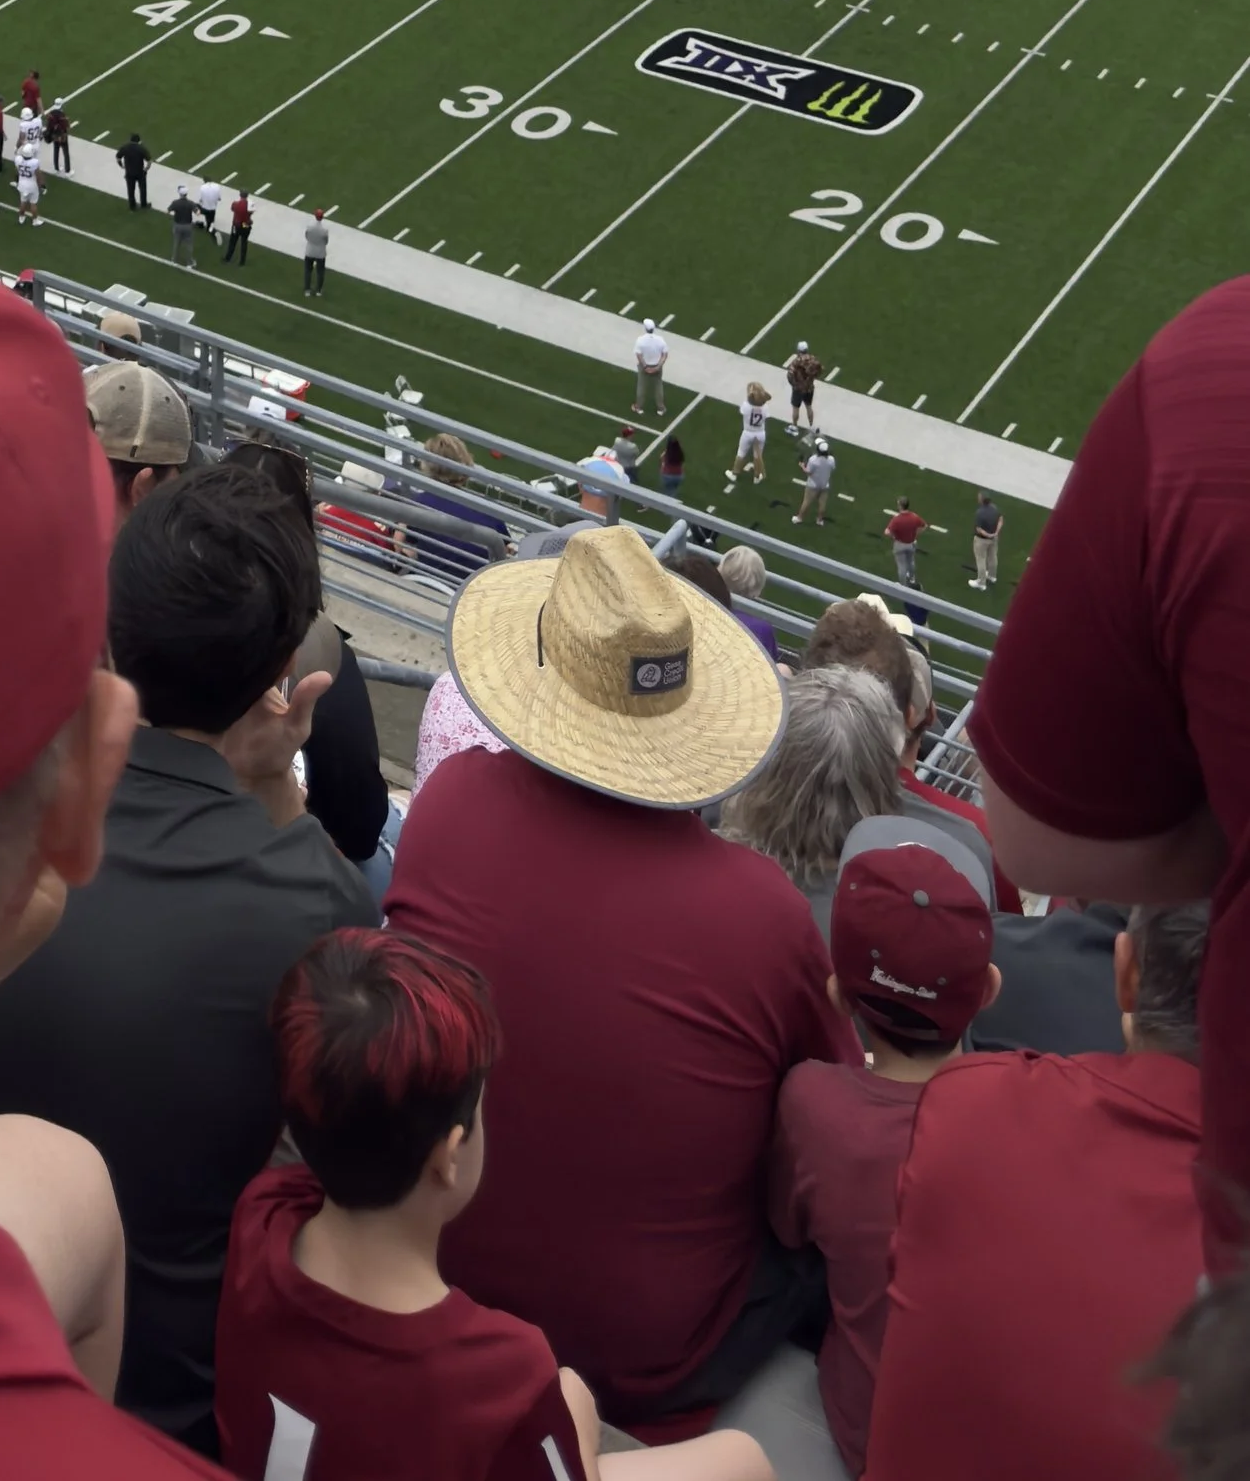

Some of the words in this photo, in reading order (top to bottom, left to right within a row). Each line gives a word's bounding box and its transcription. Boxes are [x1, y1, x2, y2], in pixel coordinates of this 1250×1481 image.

[439, 85, 572, 139] 30
[18, 164, 32, 179] 55
[789, 188, 944, 251] 20
[750, 412, 763, 426] 12
[663, 665, 685, 677] Credit
[663, 674, 682, 685] Union
